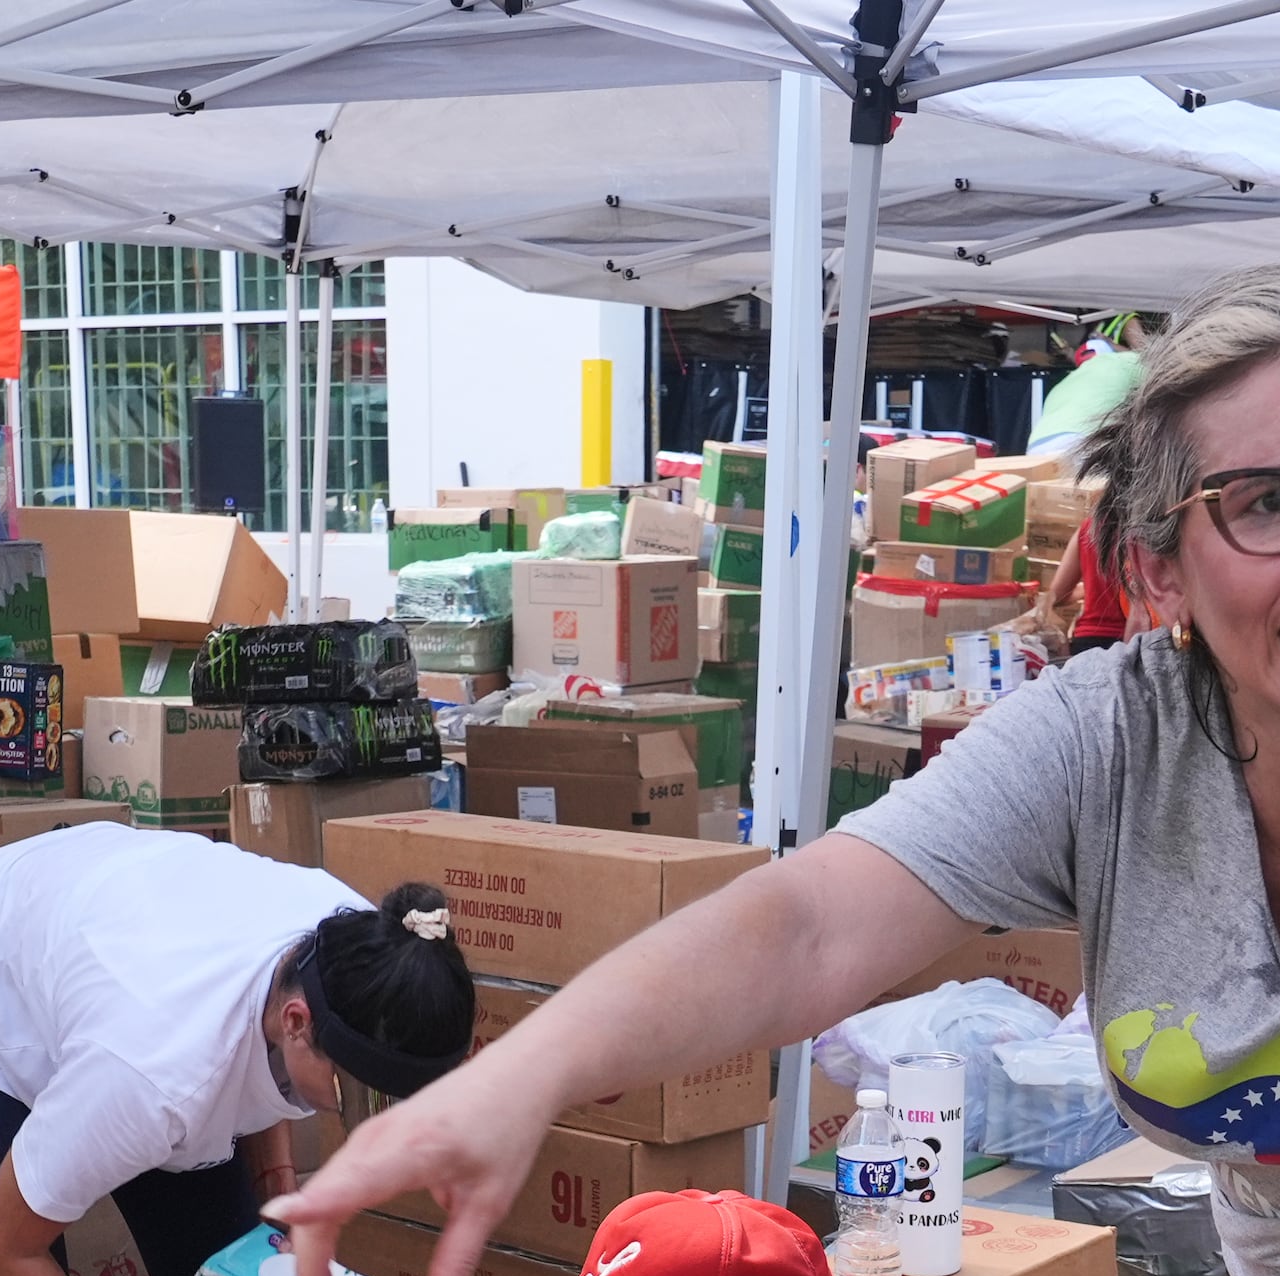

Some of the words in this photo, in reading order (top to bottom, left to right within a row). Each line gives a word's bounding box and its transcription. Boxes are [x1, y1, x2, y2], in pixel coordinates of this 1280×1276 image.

[3, 665, 13, 677] 13
[188, 713, 241, 730] SMALL
[671, 783, 684, 796] OZ
[444, 868, 482, 890] FREEZE
[486, 873, 508, 892] NOT
[511, 876, 525, 894] DO
[458, 901, 544, 927] REFRIGERATION
[547, 913, 562, 929] NO
[474, 932, 495, 949] NOT
[499, 935, 514, 951] DO
[898, 1109, 904, 1121] A
[908, 1110, 936, 1123] GIRL
[940, 1107, 962, 1122] WHO
[866, 1162, 892, 1175] Pure
[869, 1173, 890, 1185] Life
[551, 1170, 587, 1227] 16
[909, 1211, 959, 1227] PANDAS
